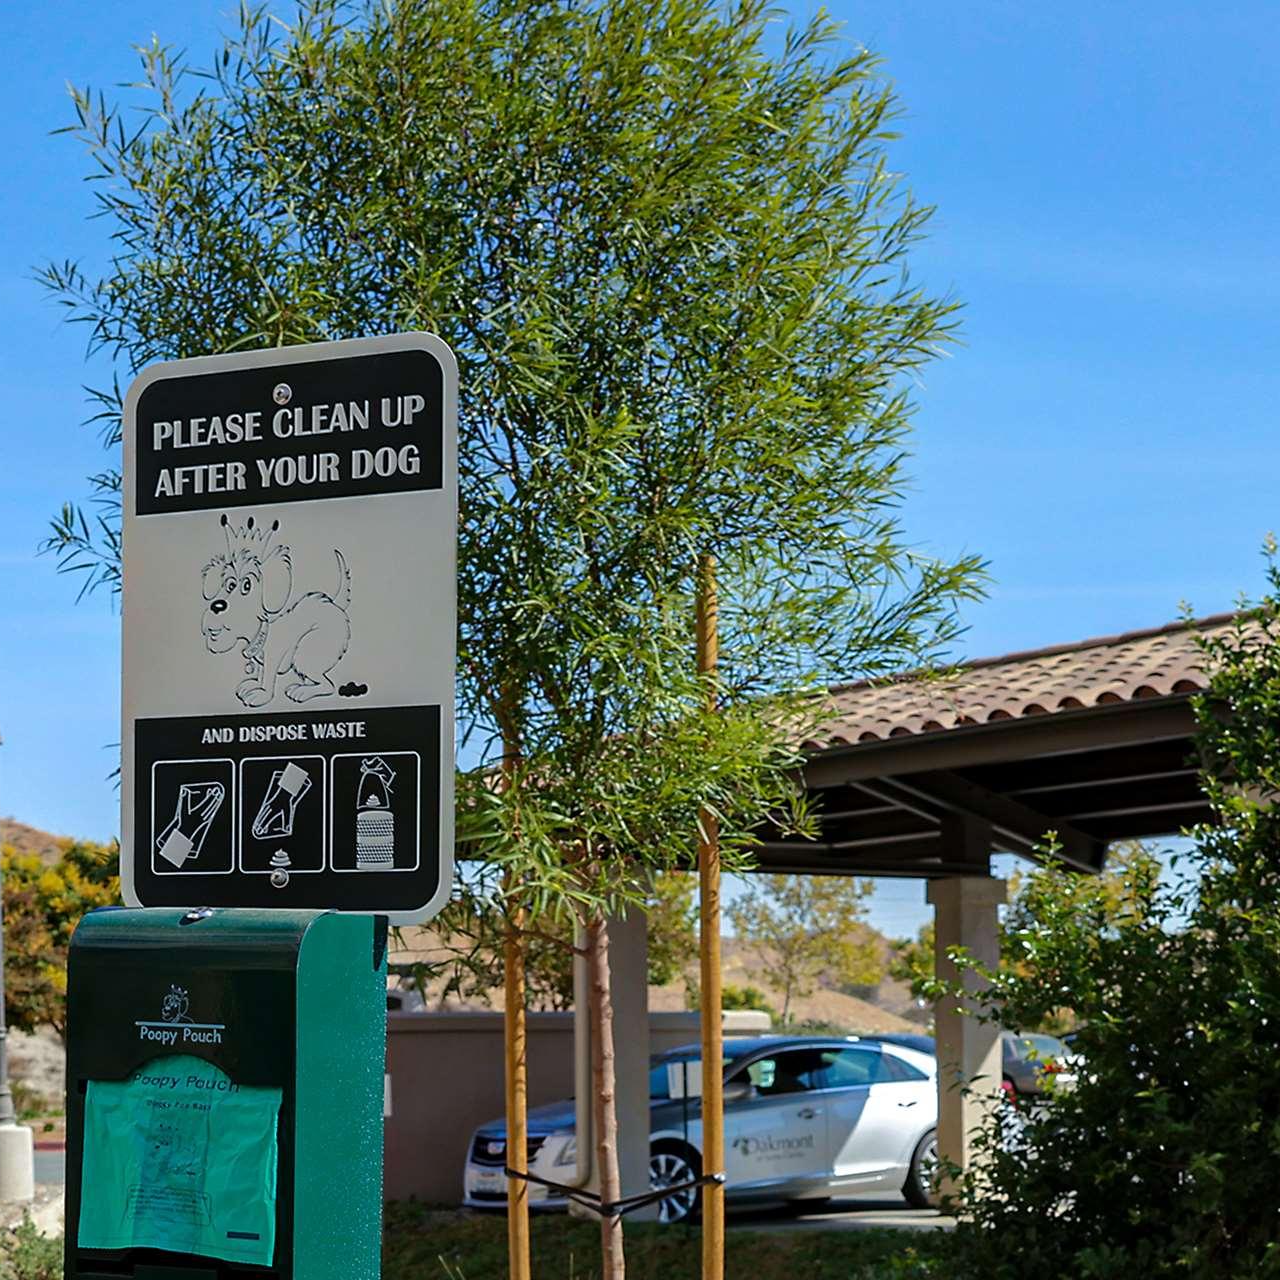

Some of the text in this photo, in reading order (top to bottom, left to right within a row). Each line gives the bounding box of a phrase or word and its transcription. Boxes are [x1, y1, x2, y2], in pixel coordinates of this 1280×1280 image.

[152, 394, 426, 451] PLEASE CLEAN UP
[154, 444, 421, 498] AFTER YOUR DOG
[200, 720, 367, 745] AND DISPOSE WASTE
[139, 1025, 222, 1046] Poopy Pouch
[134, 1073, 240, 1093] Poopy Pouch
